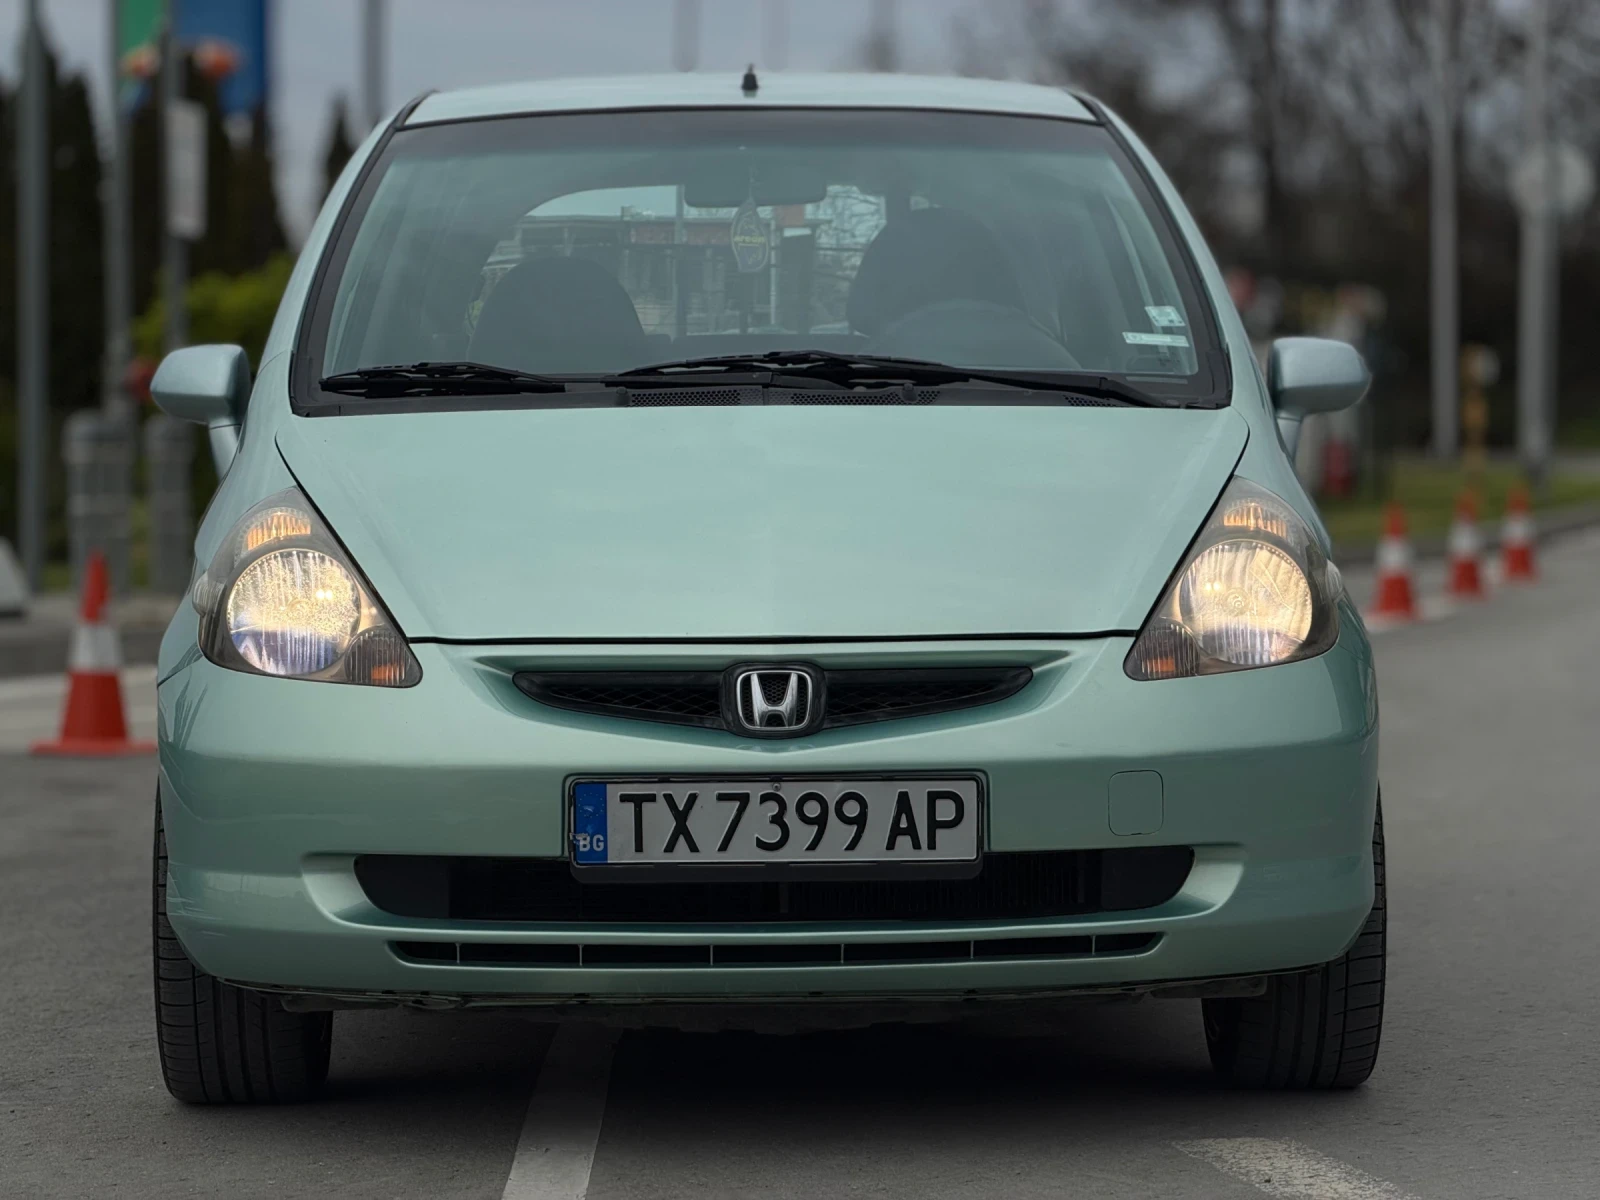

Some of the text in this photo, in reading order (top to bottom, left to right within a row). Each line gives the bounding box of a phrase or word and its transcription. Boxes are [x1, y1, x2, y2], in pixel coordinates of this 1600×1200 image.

[619, 790, 965, 853] TX 7399 AP
[578, 834, 605, 852] BG
